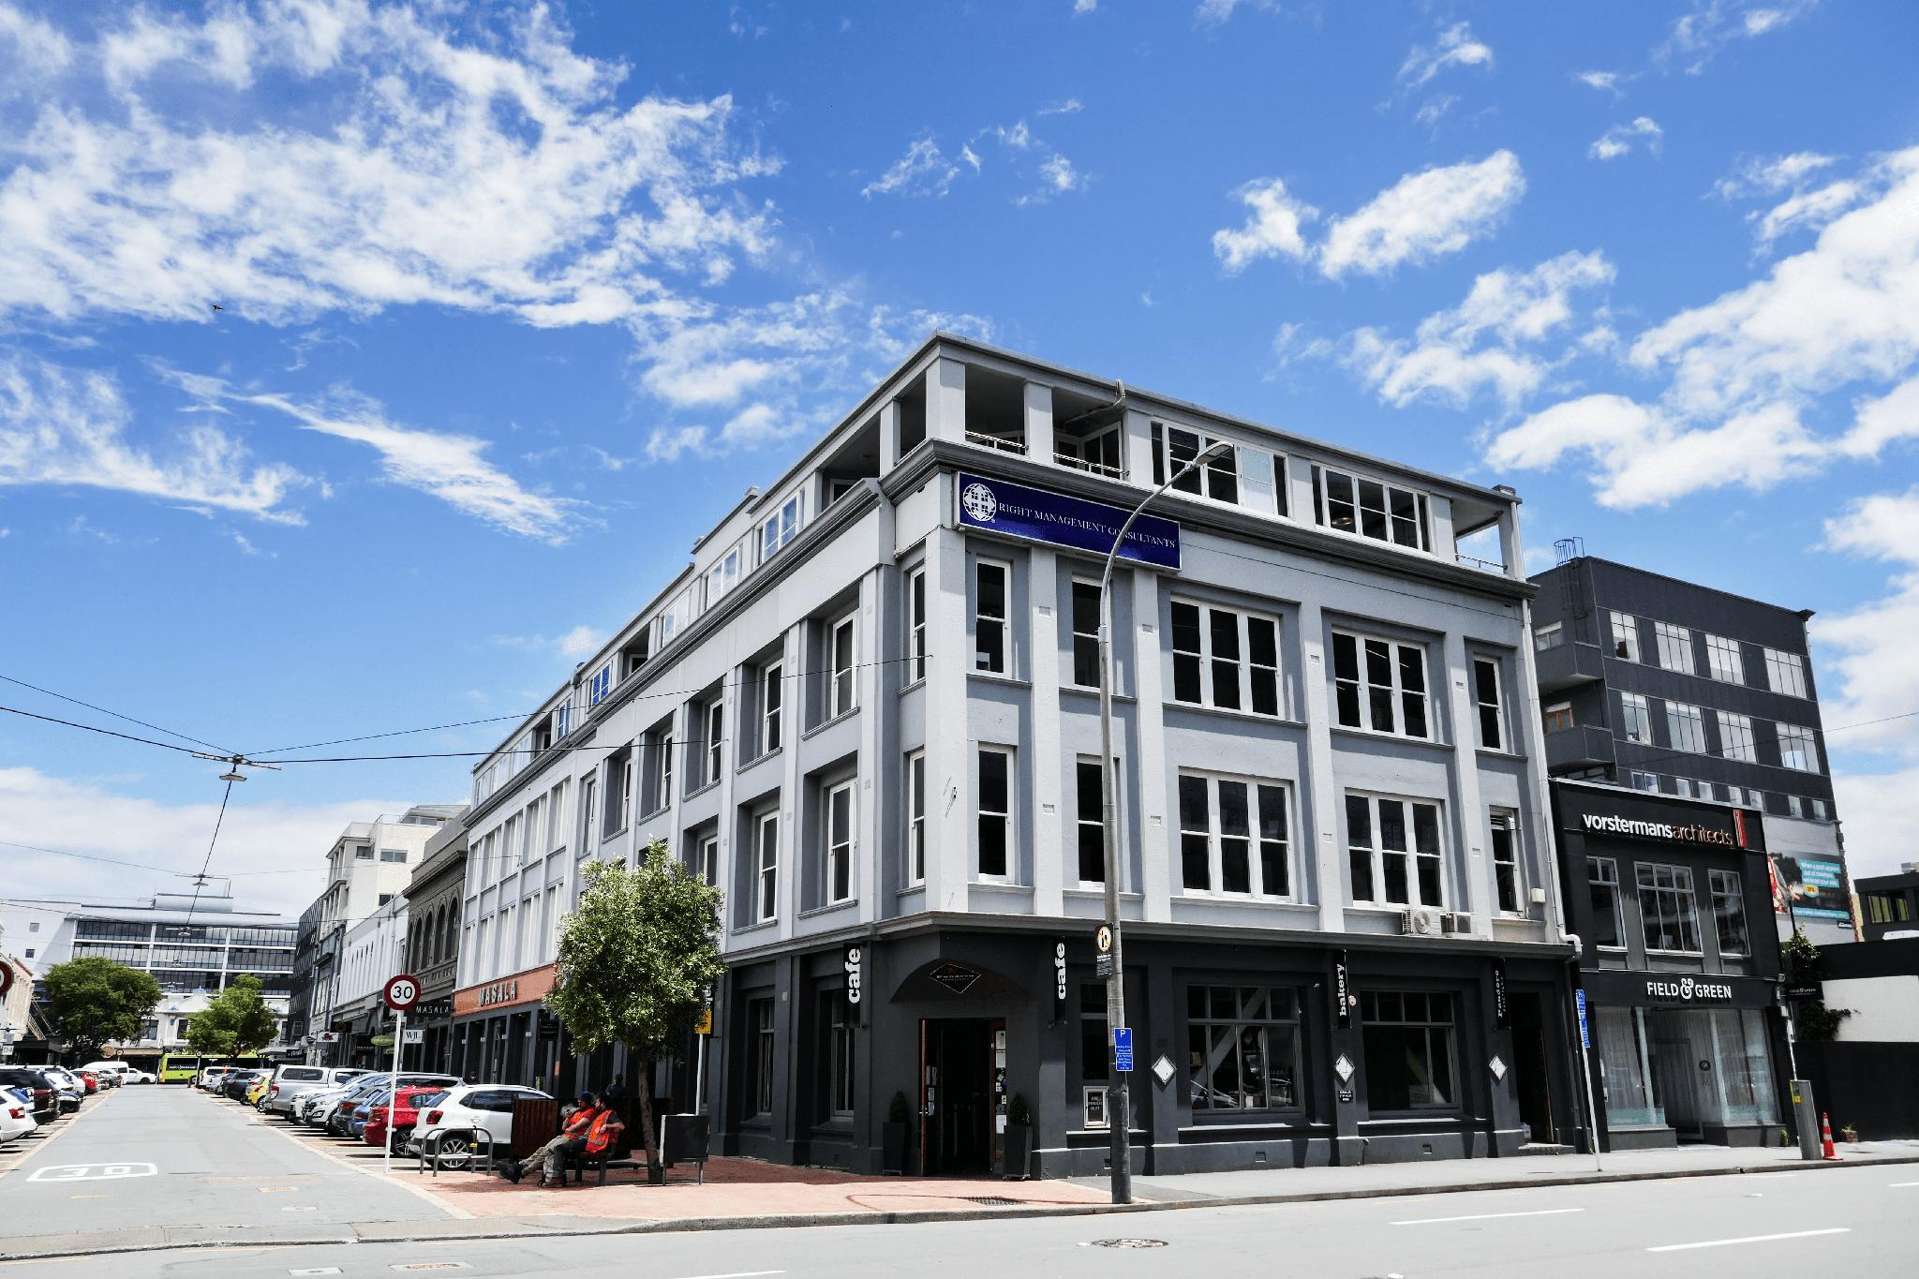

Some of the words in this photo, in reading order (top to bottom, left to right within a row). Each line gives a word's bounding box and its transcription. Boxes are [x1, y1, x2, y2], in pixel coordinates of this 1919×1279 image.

[999, 502, 1033, 517] RIGHT
[1034, 511, 1107, 534] MANAGEMENT
[844, 948, 861, 1004] cafe
[1054, 942, 1066, 1000] cafe
[393, 985, 413, 999] 30
[479, 979, 516, 1005] MASALA
[1336, 963, 1347, 1017] bakery
[1646, 981, 1679, 996] FIELD
[1679, 977, 1694, 1000] &
[1694, 986, 1732, 998] GREEN
[415, 1005, 449, 1014] MASALA
[1120, 1029, 1126, 1039] P
